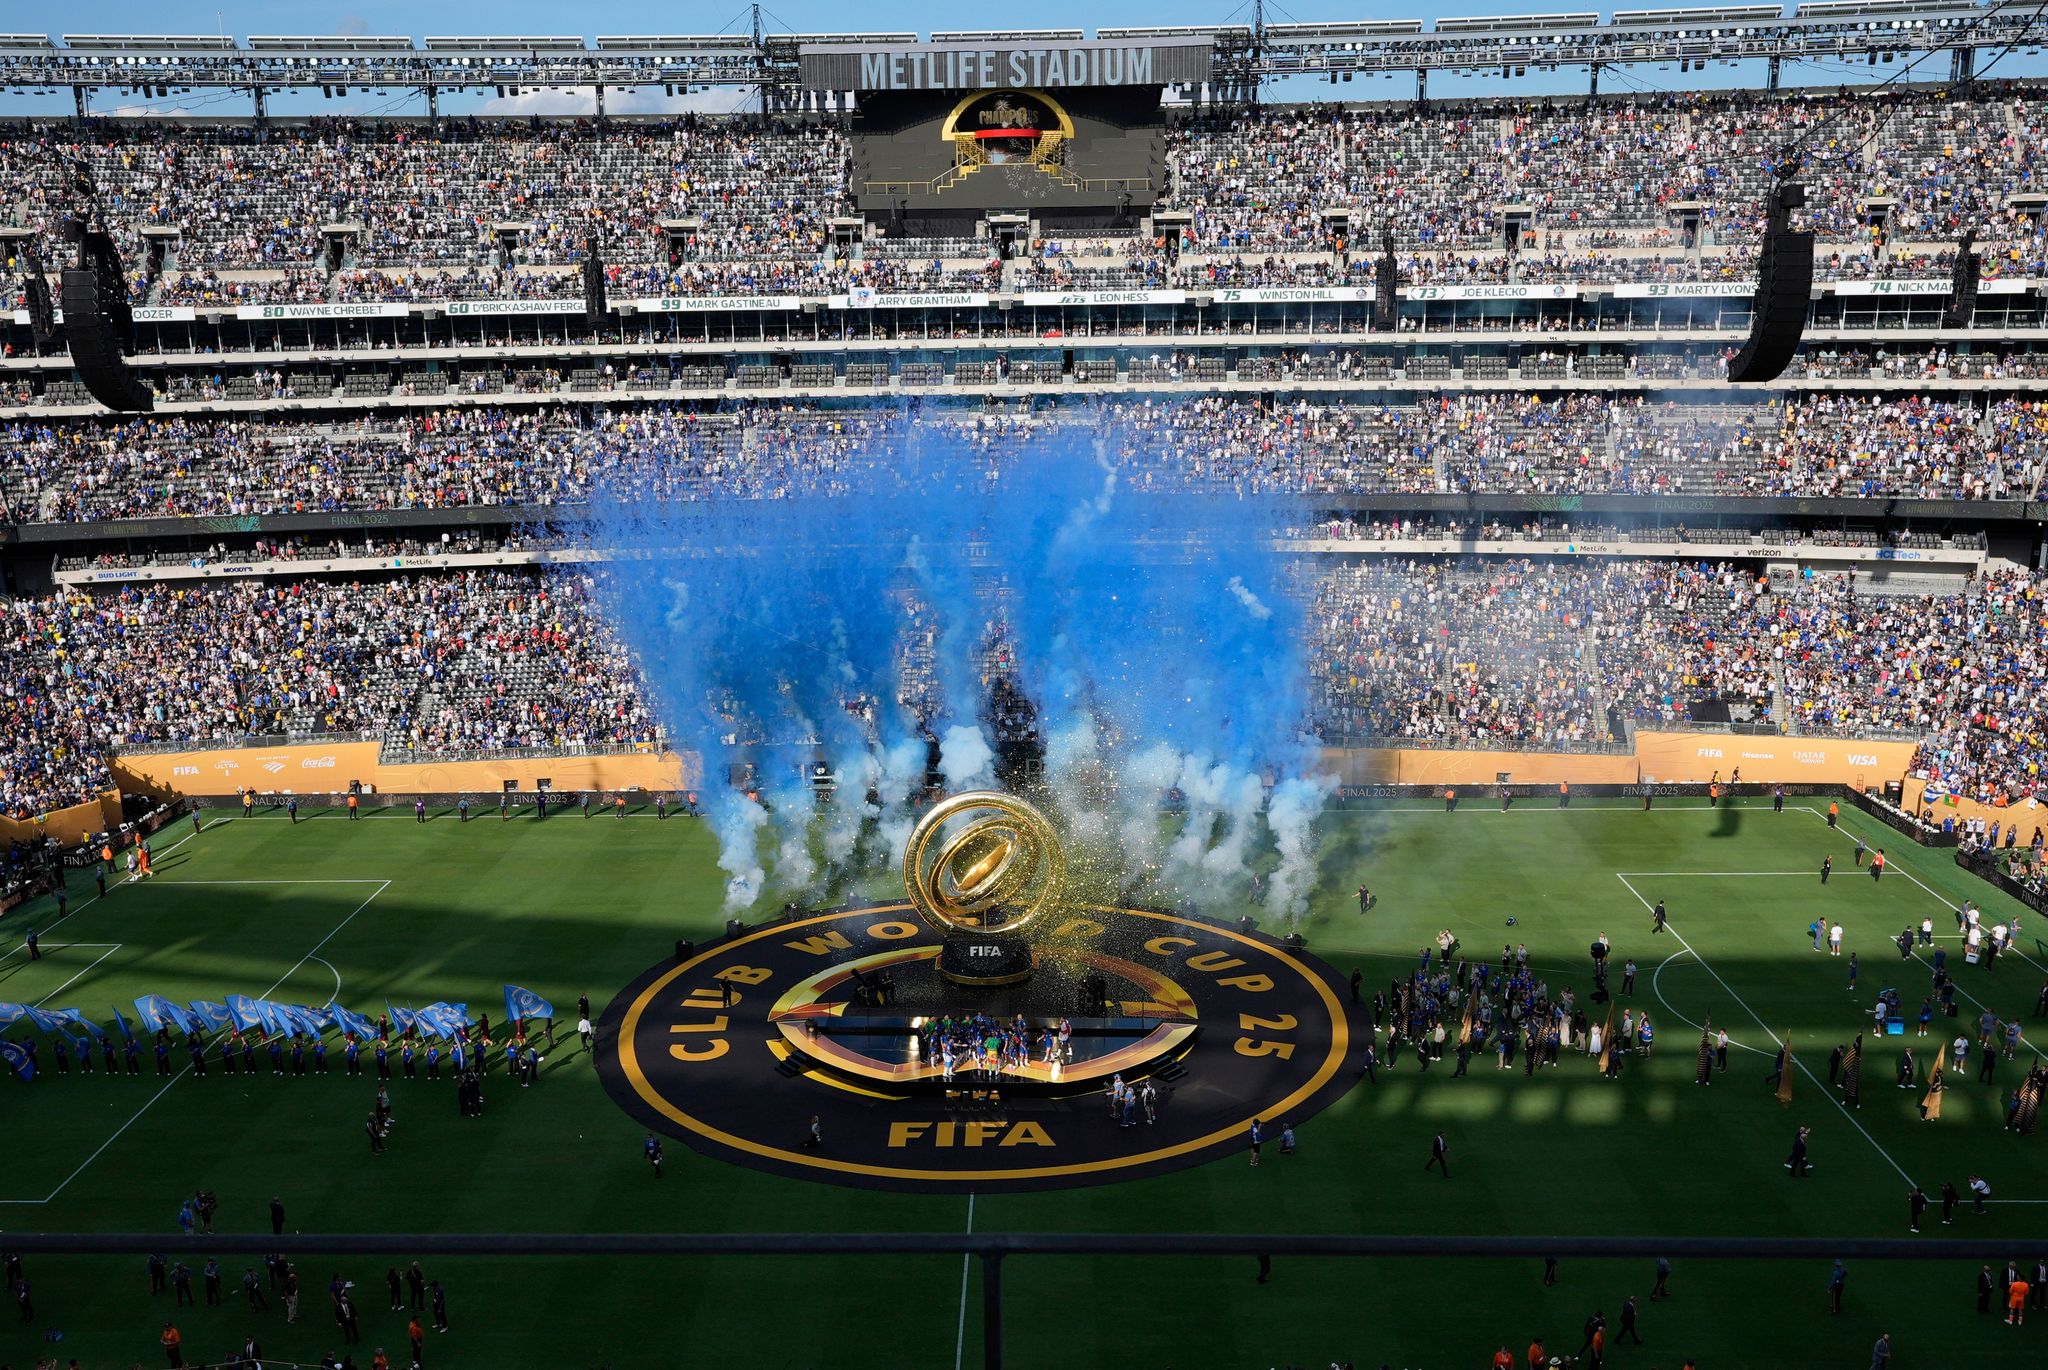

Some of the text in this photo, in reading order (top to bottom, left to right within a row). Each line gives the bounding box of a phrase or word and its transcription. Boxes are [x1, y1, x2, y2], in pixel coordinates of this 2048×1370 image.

[861, 48, 1152, 90] METLIFE STADIUM
[1417, 287, 1527, 298] 73 JOE KLECKO
[1648, 284, 1757, 296] 93 MARTY LYONS
[1870, 282, 1891, 293] 74
[1897, 282, 1925, 292] NICK
[878, 296, 907, 305] ARRY
[909, 295, 972, 305] GRANTHAM
[1093, 293, 1120, 302] LEON
[1122, 293, 1149, 302] HESS
[1223, 289, 1335, 301] 75 WINSTON HILL
[449, 303, 469, 313] 60
[554, 302, 587, 311] FERGU
[661, 298, 780, 310] 99 MARK GASTINEAU
[133, 309, 173, 319] OOZER
[263, 305, 383, 317] 80 WAYNE CHREBET
[1655, 500, 1714, 510] FINAL 2025
[331, 514, 389, 525] FINAL 2025
[1747, 549, 1781, 557] verizon
[1876, 549, 1921, 560] HCLTech
[1697, 748, 1724, 758] FIFA
[1741, 751, 1775, 759] Hisense
[1792, 750, 1825, 759] QATAR
[1846, 753, 1878, 766] VISA
[173, 766, 199, 776] FIFA
[1373, 787, 1397, 797] 2025
[1622, 786, 1679, 796] FINA 2025
[513, 794, 568, 804] FINA 2025
[2021, 889, 2040, 910] FINAL
[969, 945, 1002, 957] FIFA
[668, 964, 774, 1062] CLUB
[1143, 936, 1276, 993] CUP
[1233, 1012, 1299, 1061] 25
[887, 1120, 1057, 1148] FIFA
